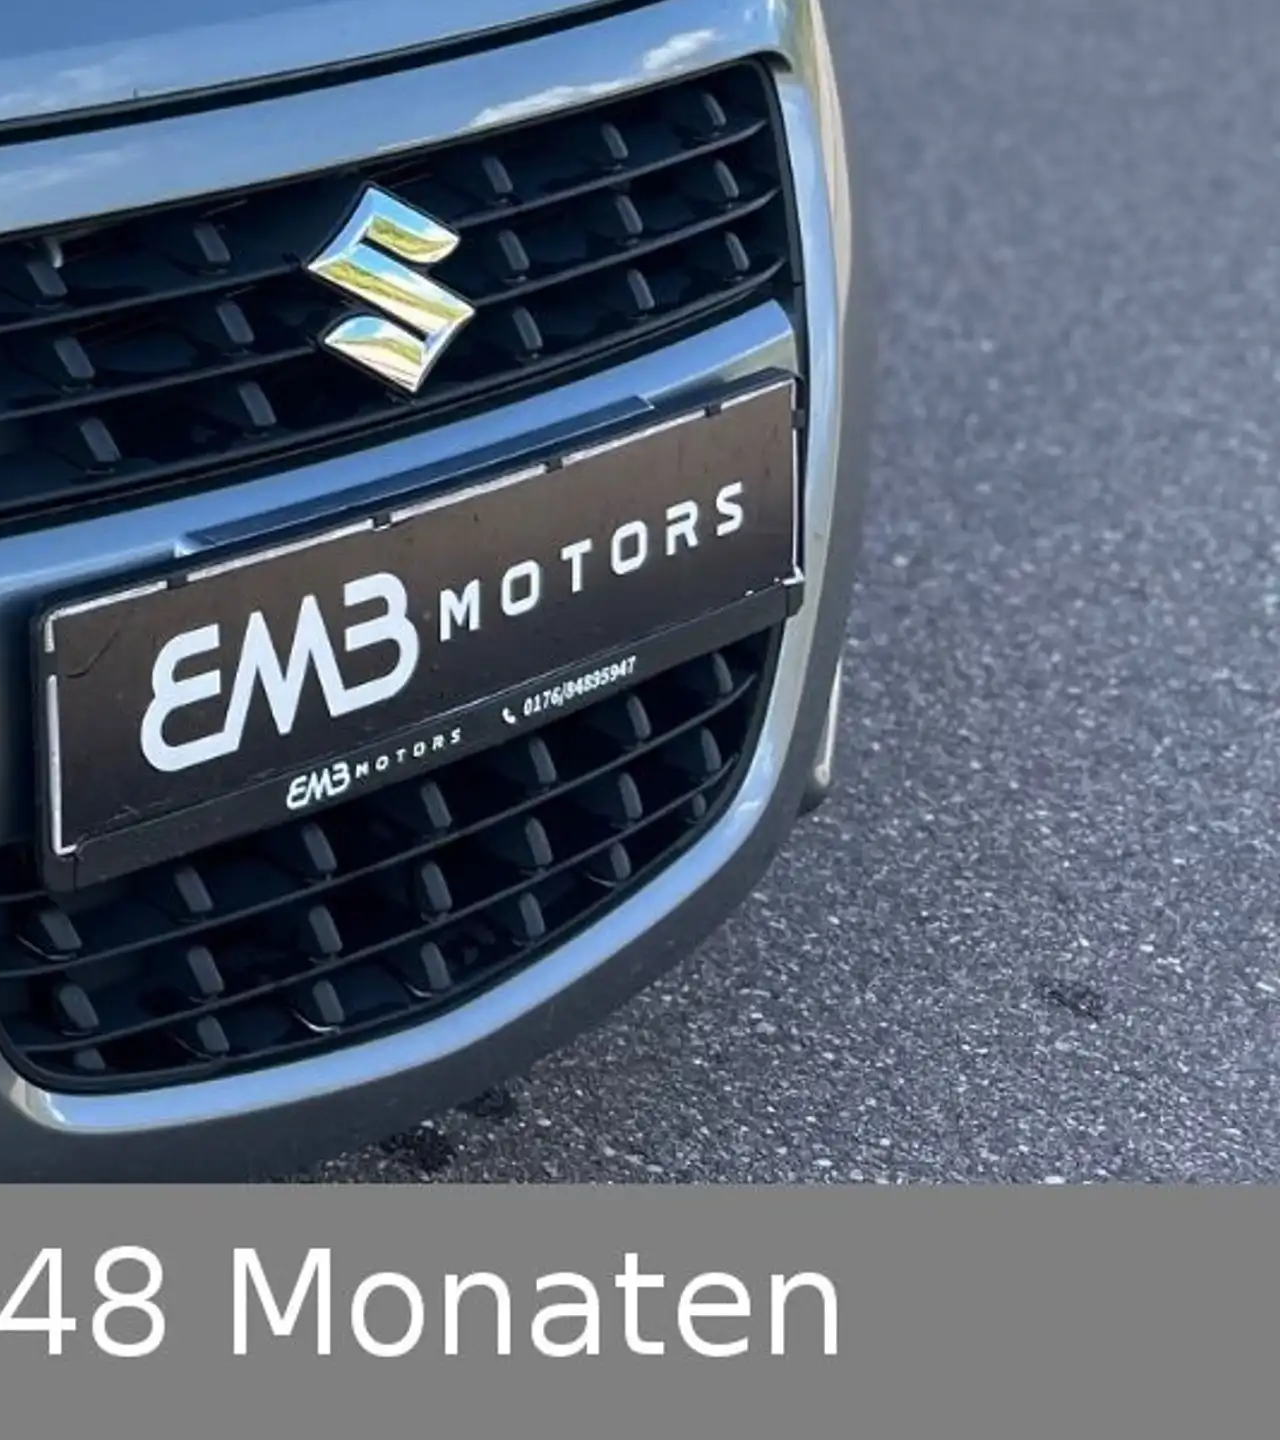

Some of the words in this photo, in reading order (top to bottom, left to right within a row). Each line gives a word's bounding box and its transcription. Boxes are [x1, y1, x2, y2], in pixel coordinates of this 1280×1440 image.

[140, 572, 420, 772] EMB
[439, 480, 744, 642] MOTORS
[286, 762, 351, 810] EMB
[355, 727, 462, 778] MOTORS
